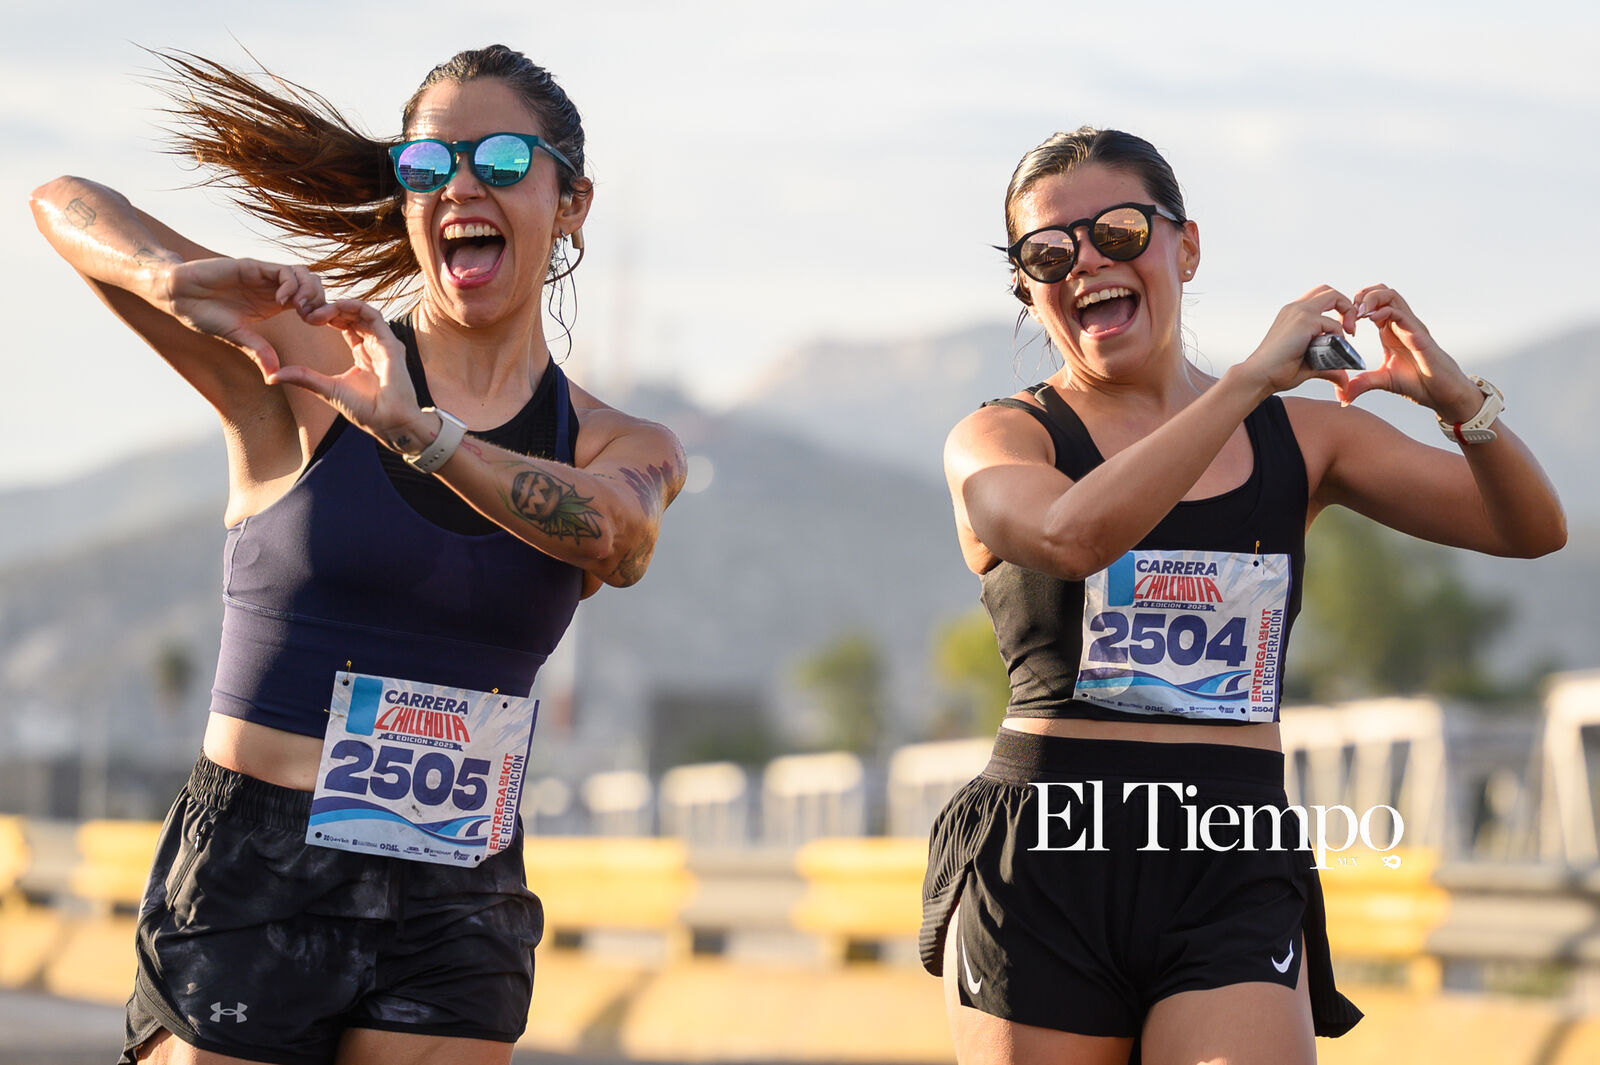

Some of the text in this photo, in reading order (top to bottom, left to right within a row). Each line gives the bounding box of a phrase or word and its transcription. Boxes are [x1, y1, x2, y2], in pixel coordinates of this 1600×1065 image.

[1134, 574, 1223, 603] CHILCHOTA
[1136, 559, 1218, 576] CARRERA
[1088, 611, 1248, 667] 2504
[1251, 641, 1267, 703] ENTREGA
[1261, 608, 1272, 629] KIT
[1262, 609, 1283, 702] DE RECUPERACIÓN
[374, 706, 470, 743] CHILCHOTA
[384, 689, 468, 715] CARRERA
[433, 741, 454, 749] 2025
[324, 739, 491, 811] 2505
[489, 788, 507, 850] ENTREGA
[501, 753, 514, 775] KIT
[498, 755, 524, 851] DE RECUPERACIÓN
